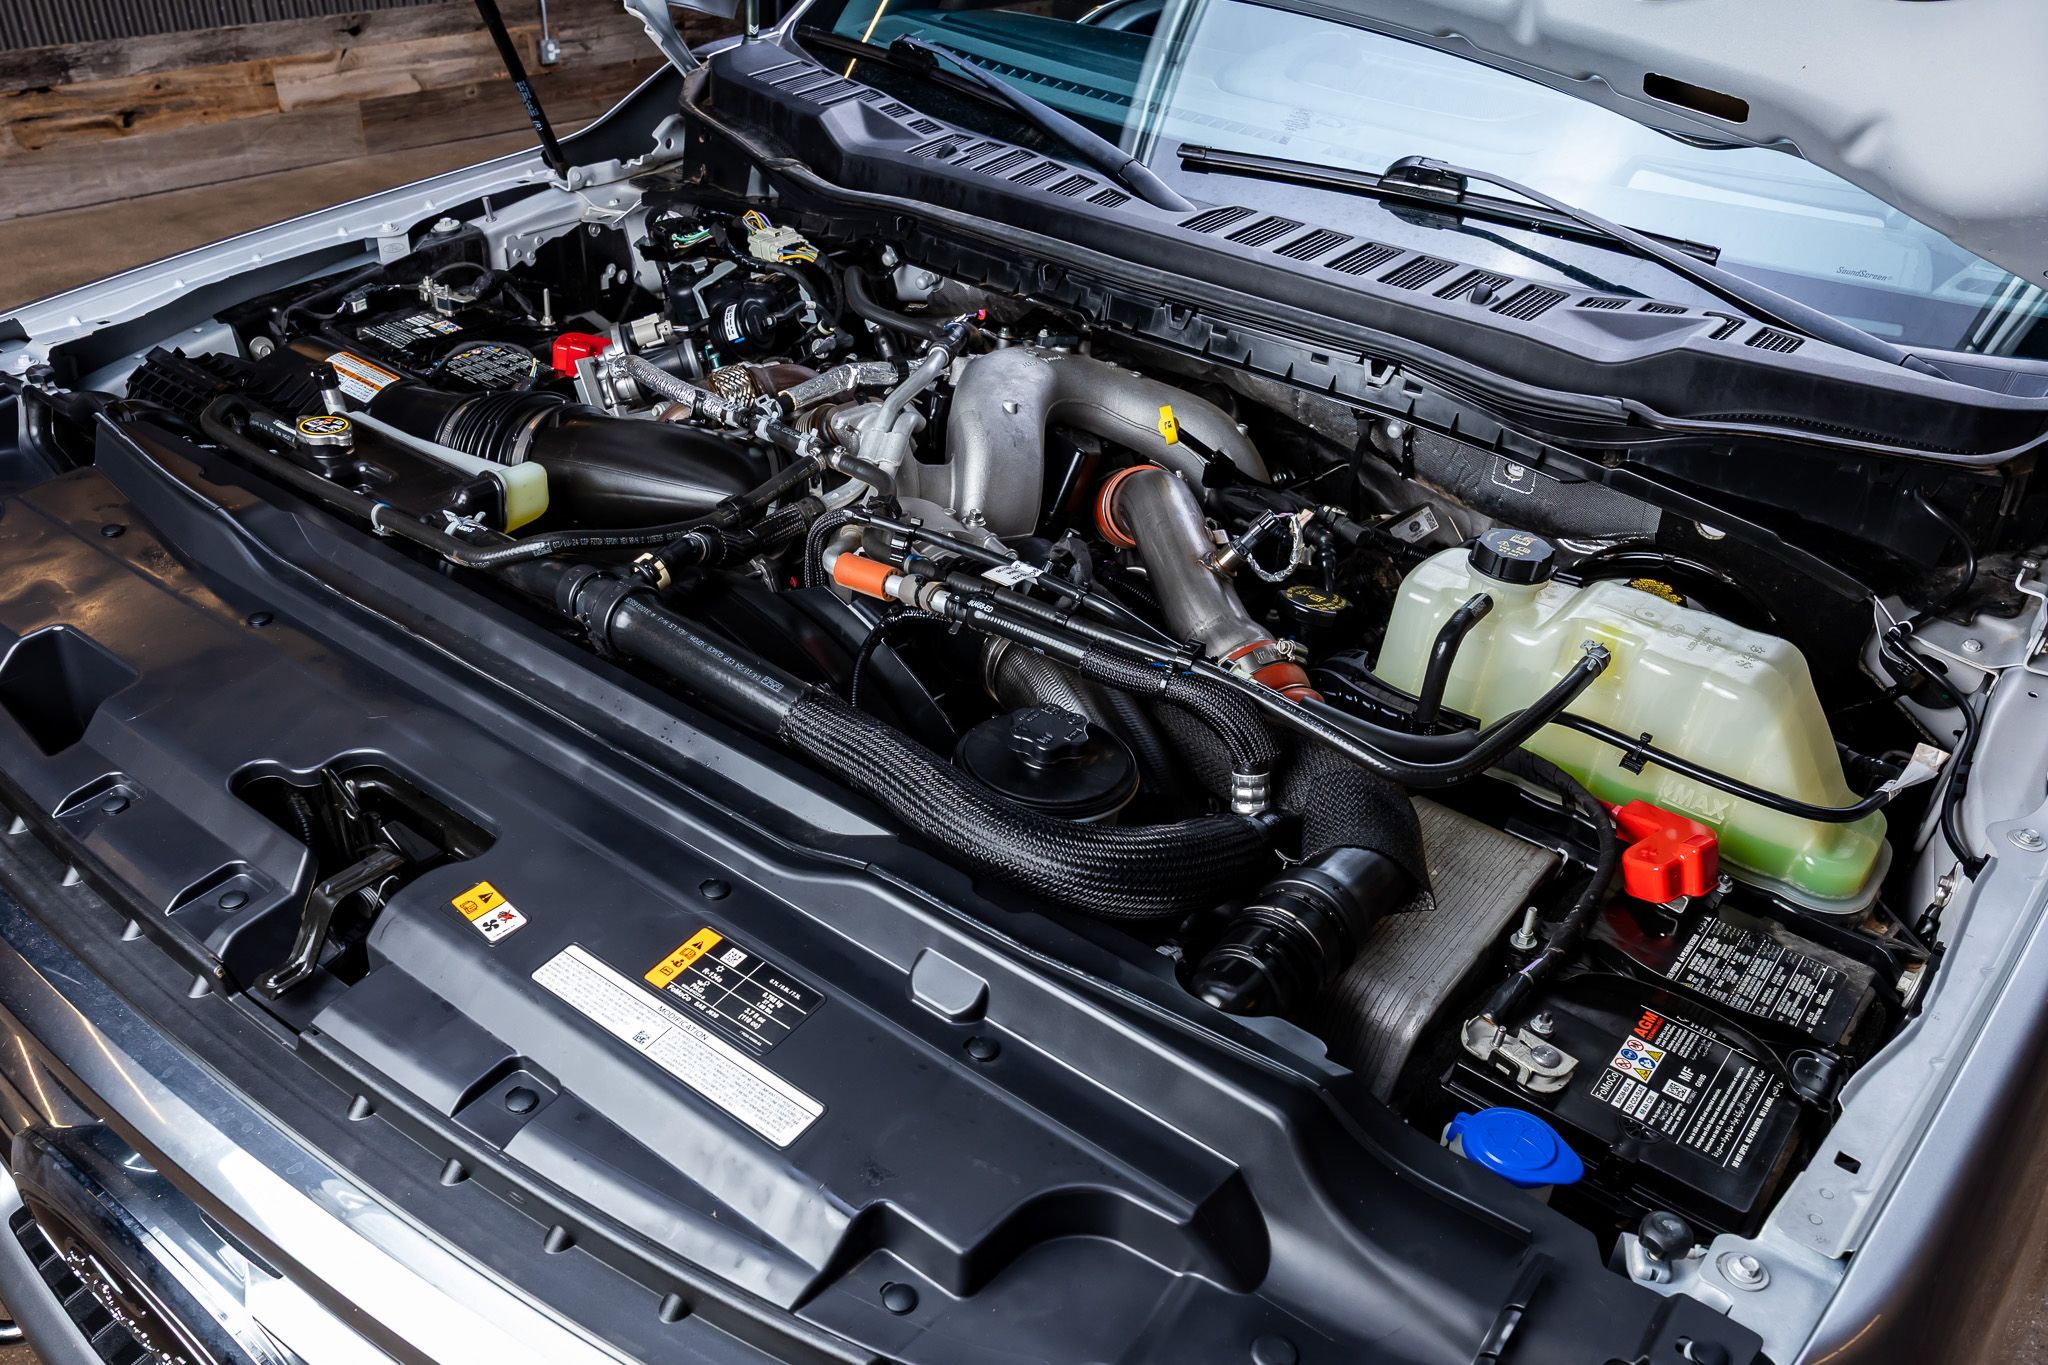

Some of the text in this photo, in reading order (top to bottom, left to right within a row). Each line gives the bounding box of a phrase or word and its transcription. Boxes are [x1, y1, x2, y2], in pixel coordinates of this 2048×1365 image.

[1836, 266, 1888, 281] SoundScreen
[1672, 783, 1730, 822] MAX
[702, 968, 723, 983] R-134a
[690, 983, 705, 993] PAG
[667, 984, 691, 1002] FoMoCo
[694, 1001, 707, 1010] SAE
[775, 1000, 784, 1008] kg
[657, 1006, 709, 1041] MODIFICATION
[1634, 1011, 1658, 1038] AGM
[1678, 1066, 1694, 1082] MF
[1597, 1072, 1619, 1100] FoMoCo
[1625, 1086, 1645, 1112] %s %s
[1735, 1153, 1743, 1162] NOT
[1738, 1144, 1749, 1155] OPEN.
